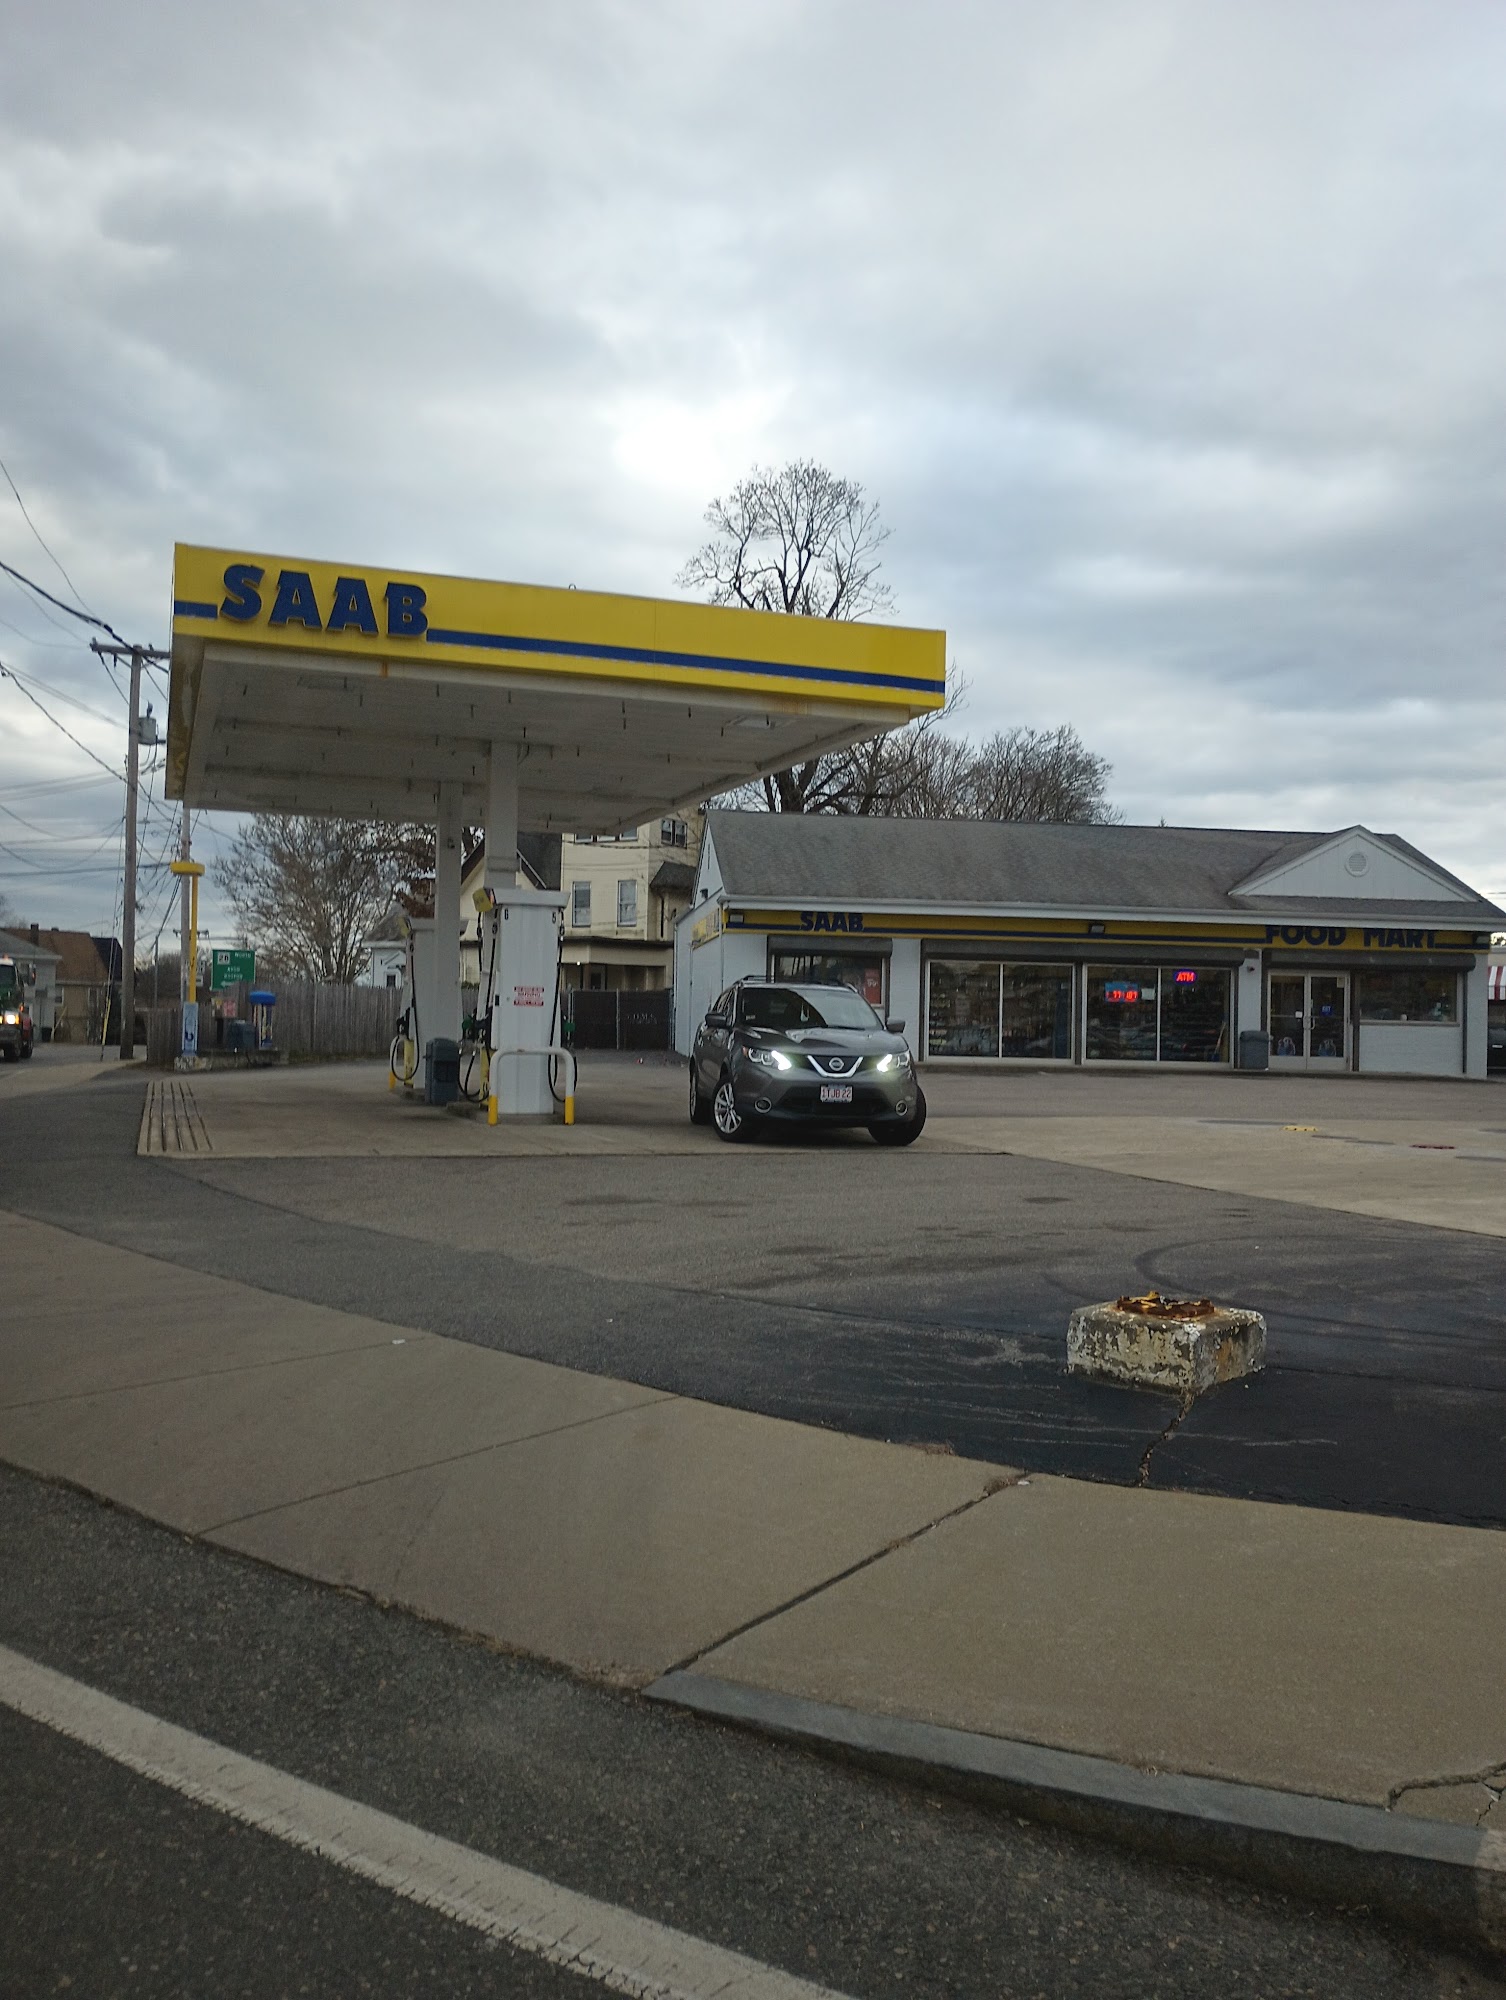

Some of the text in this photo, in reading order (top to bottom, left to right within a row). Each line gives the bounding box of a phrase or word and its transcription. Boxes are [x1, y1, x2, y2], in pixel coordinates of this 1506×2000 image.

[220, 564, 428, 637] SAAB
[801, 911, 864, 932] SAAB
[1265, 925, 1438, 949] FOOD MART
[1176, 971, 1195, 982] ATM
